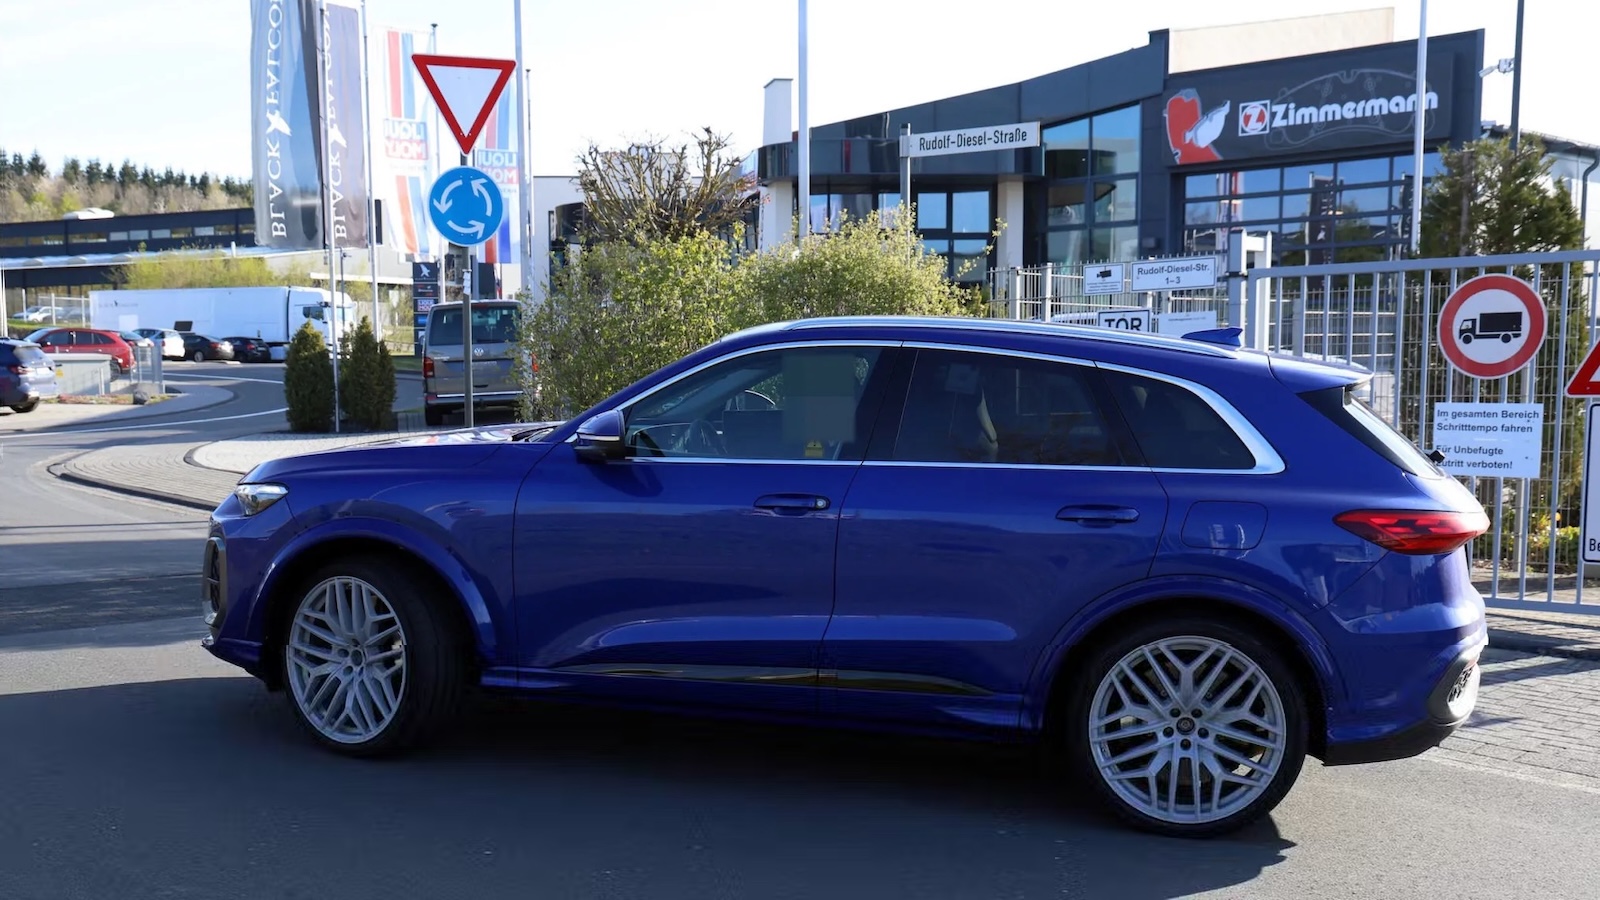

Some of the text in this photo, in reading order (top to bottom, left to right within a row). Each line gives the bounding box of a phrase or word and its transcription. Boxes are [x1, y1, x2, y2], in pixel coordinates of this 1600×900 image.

[1271, 91, 1438, 128] Zimmermann
[919, 128, 1028, 151] Rudolf-Diesel-Straße
[1137, 263, 1210, 275] Rudolf-Diesel-Str.
[1104, 317, 1143, 331] TOR
[1437, 410, 1540, 420] Im gesamten Bereich
[1436, 423, 1533, 434] Schritttempo fahren
[1454, 445, 1504, 457] Unbefugte
[1466, 460, 1513, 469] verboten!
